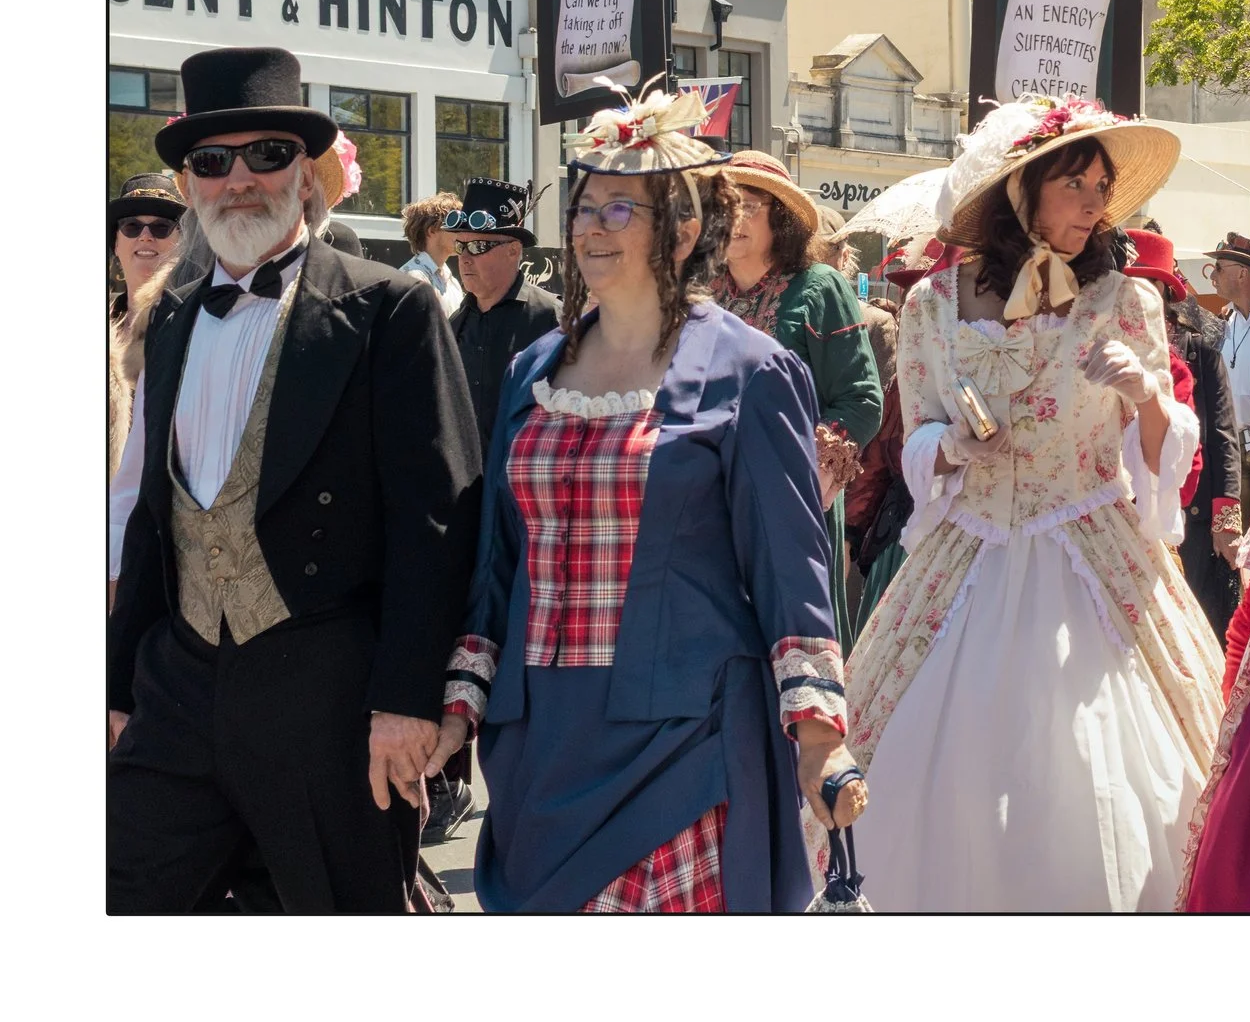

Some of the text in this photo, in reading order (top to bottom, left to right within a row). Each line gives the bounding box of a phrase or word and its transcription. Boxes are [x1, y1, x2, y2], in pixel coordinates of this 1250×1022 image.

[563, 11, 624, 38] taking it off
[1013, 4, 1034, 21] AN
[561, 41, 575, 55] the
[601, 34, 628, 54] now?
[1013, 32, 1097, 63] SUFFRAGETTES
[1038, 58, 1061, 77] FOR
[820, 181, 889, 210] espre
